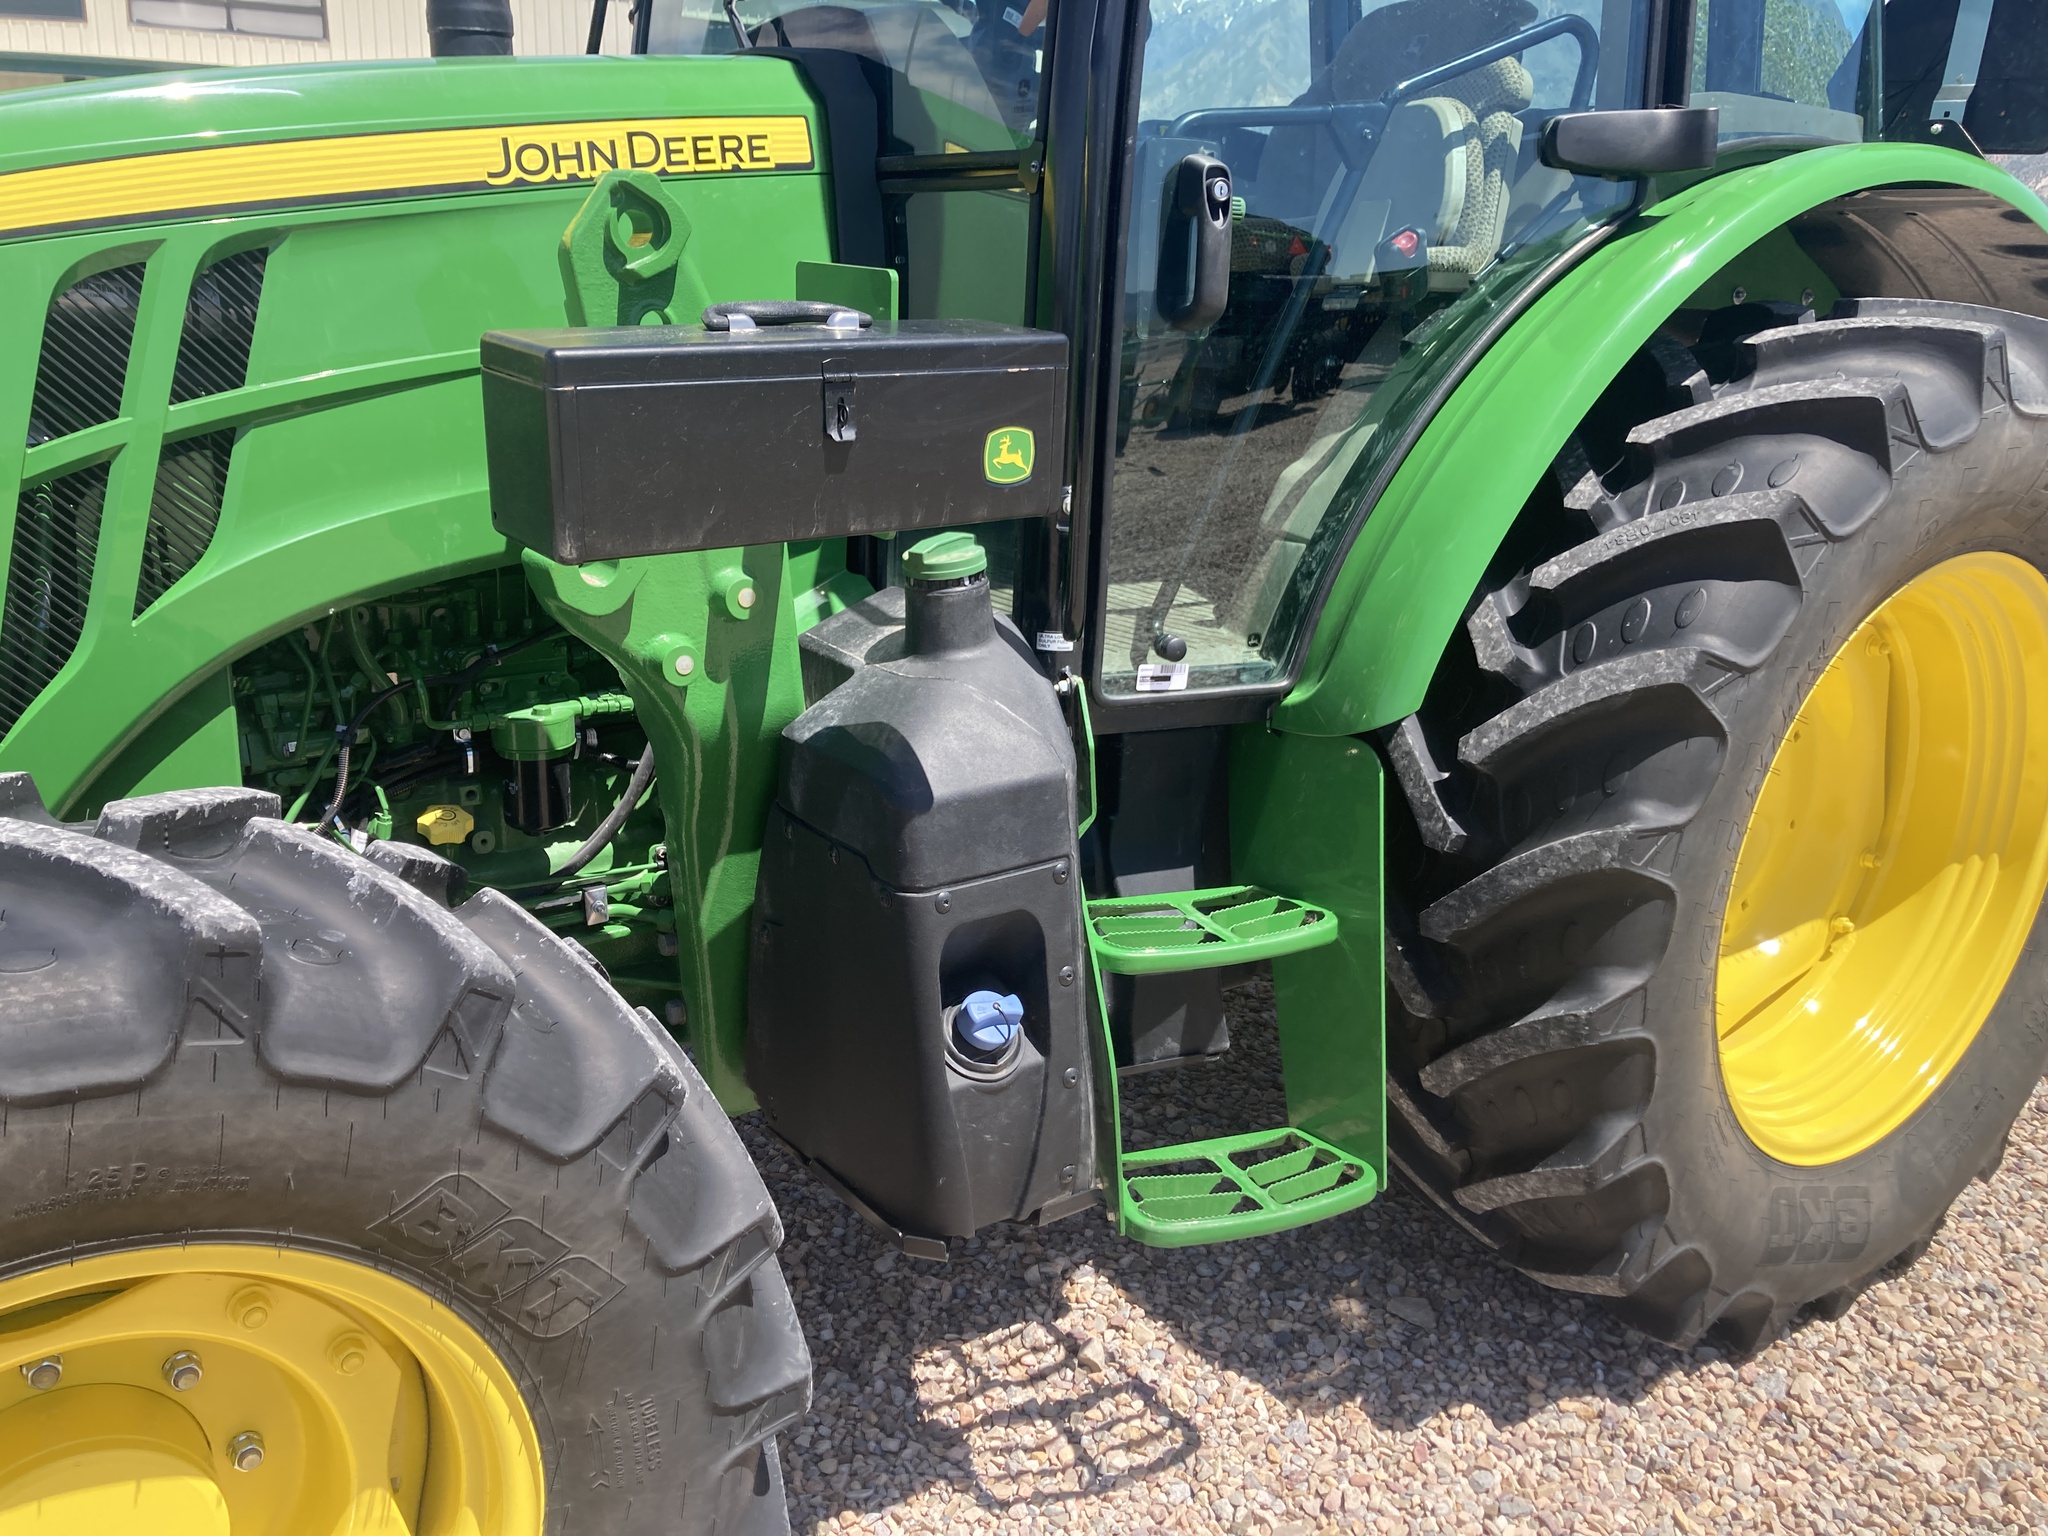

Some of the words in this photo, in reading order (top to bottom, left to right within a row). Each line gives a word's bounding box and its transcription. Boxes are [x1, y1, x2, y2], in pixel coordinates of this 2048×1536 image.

[486, 136, 619, 178] JOHN
[626, 131, 771, 168] DEERE
[375, 1178, 615, 1335] BKT
[640, 1394, 661, 1471] TUBELESS
